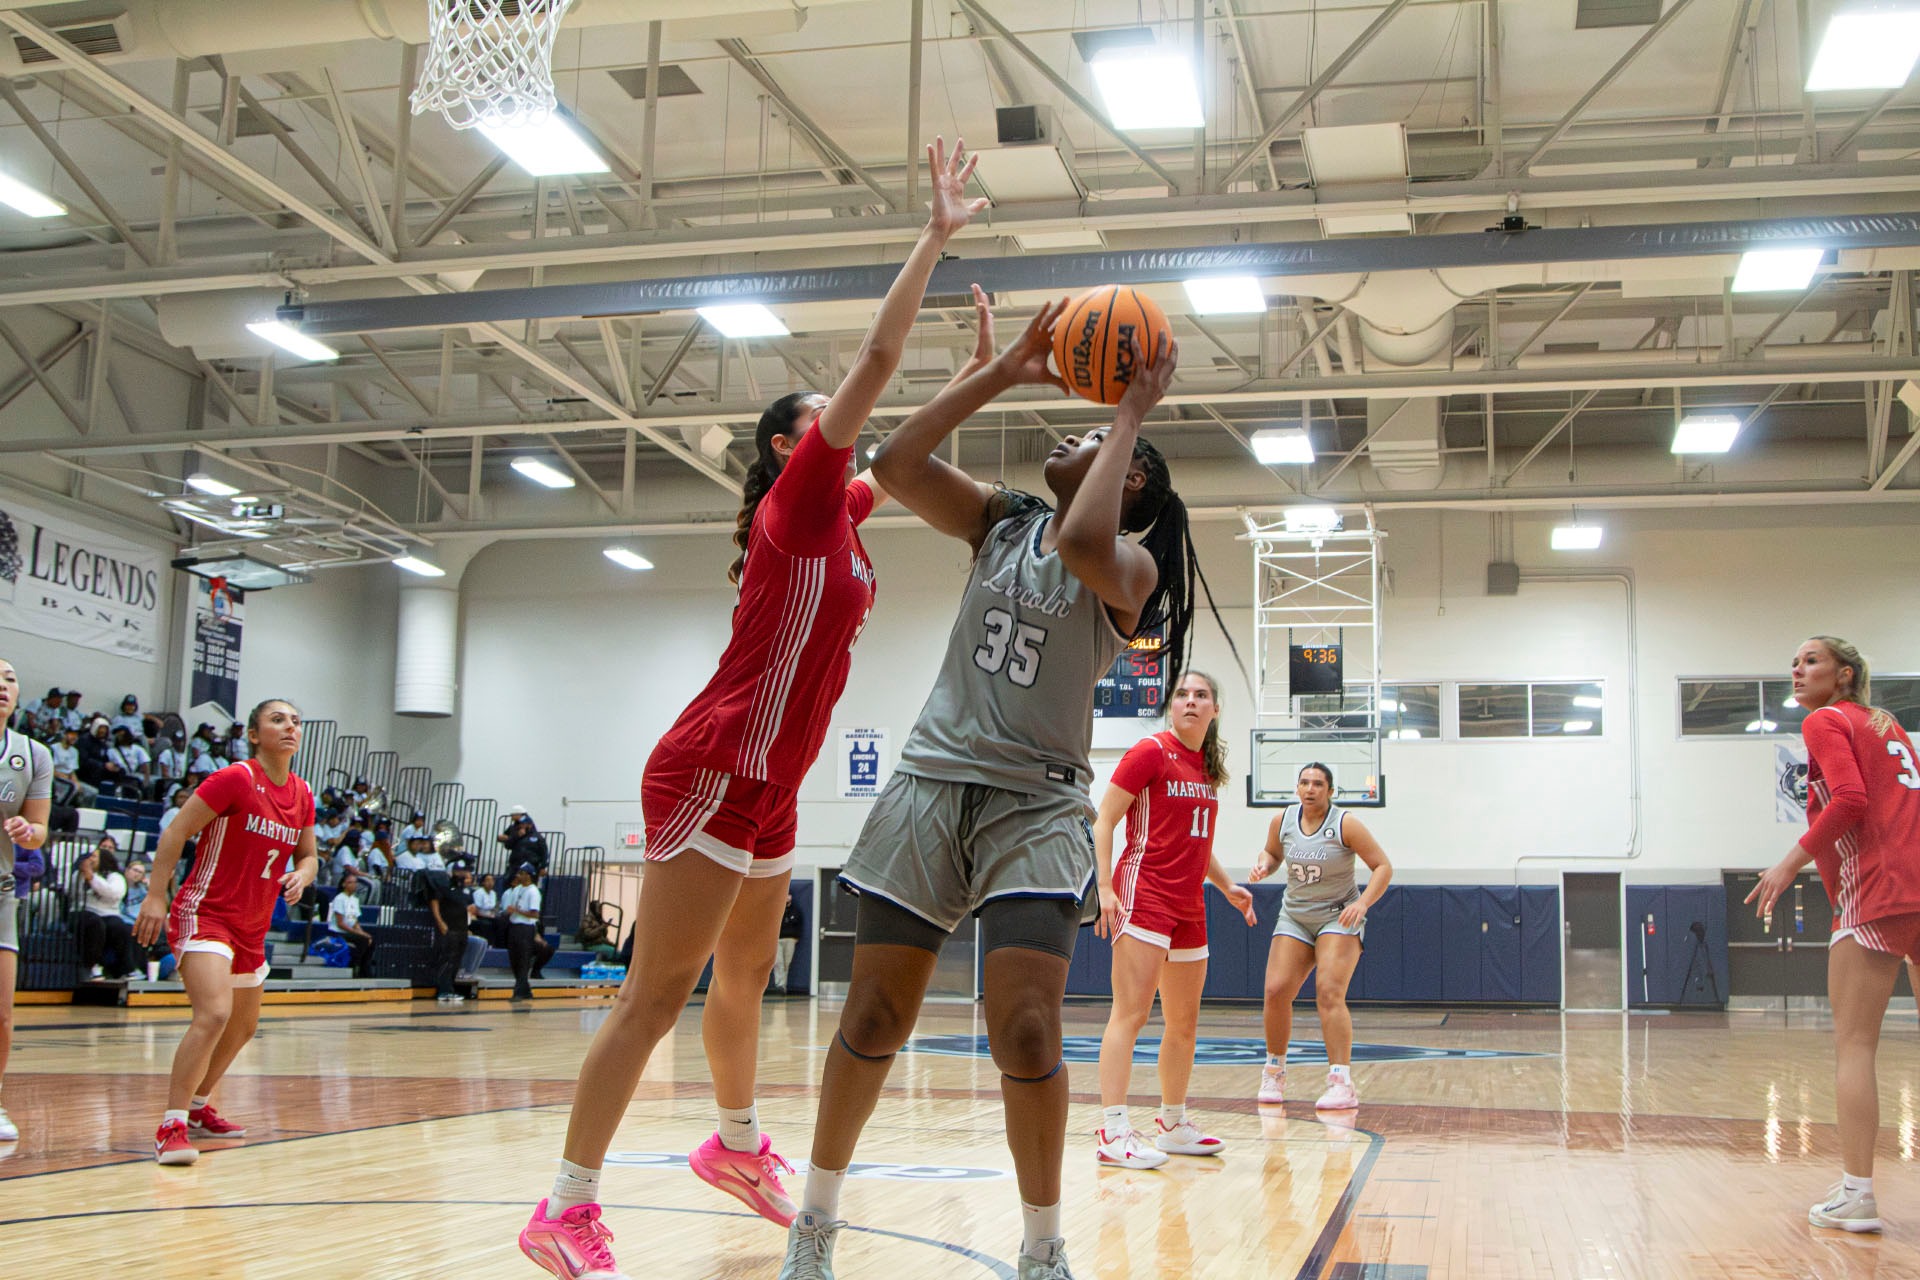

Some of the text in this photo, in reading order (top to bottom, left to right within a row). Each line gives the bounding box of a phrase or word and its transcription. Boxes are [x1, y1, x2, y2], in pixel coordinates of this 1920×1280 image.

[1073, 311, 1101, 388] Wilson
[1113, 324, 1136, 385] NCAA
[29, 524, 157, 611] LEGENDS
[41, 596, 141, 631] BANK
[973, 606, 1048, 689] 35
[1303, 649, 1337, 664] 9:36
[1130, 653, 1159, 677] 56
[1138, 678, 1161, 687] FOULS
[1147, 687, 1158, 705] 0
[857, 762, 870, 773] 24
[1886, 739, 1920, 790] 3
[1190, 806, 1210, 838] 11
[260, 848, 280, 880] 2
[1287, 842, 1329, 861] Lincoln
[1291, 862, 1322, 885] 32
